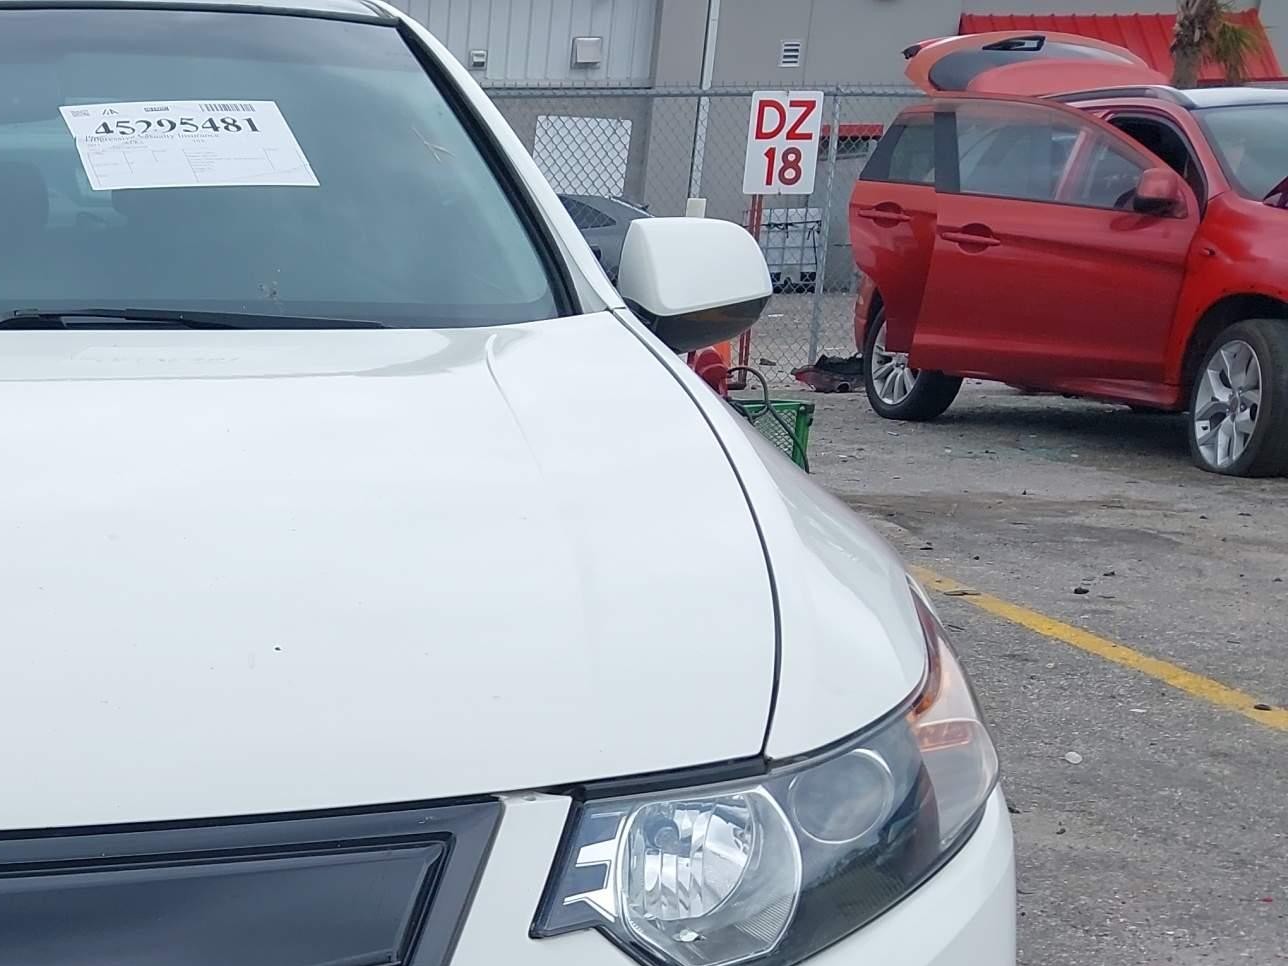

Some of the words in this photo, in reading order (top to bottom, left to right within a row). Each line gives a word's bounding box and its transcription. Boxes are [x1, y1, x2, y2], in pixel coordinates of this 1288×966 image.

[94, 115, 262, 136] 45295481
[755, 99, 817, 141] DZ
[764, 146, 802, 186] 18
